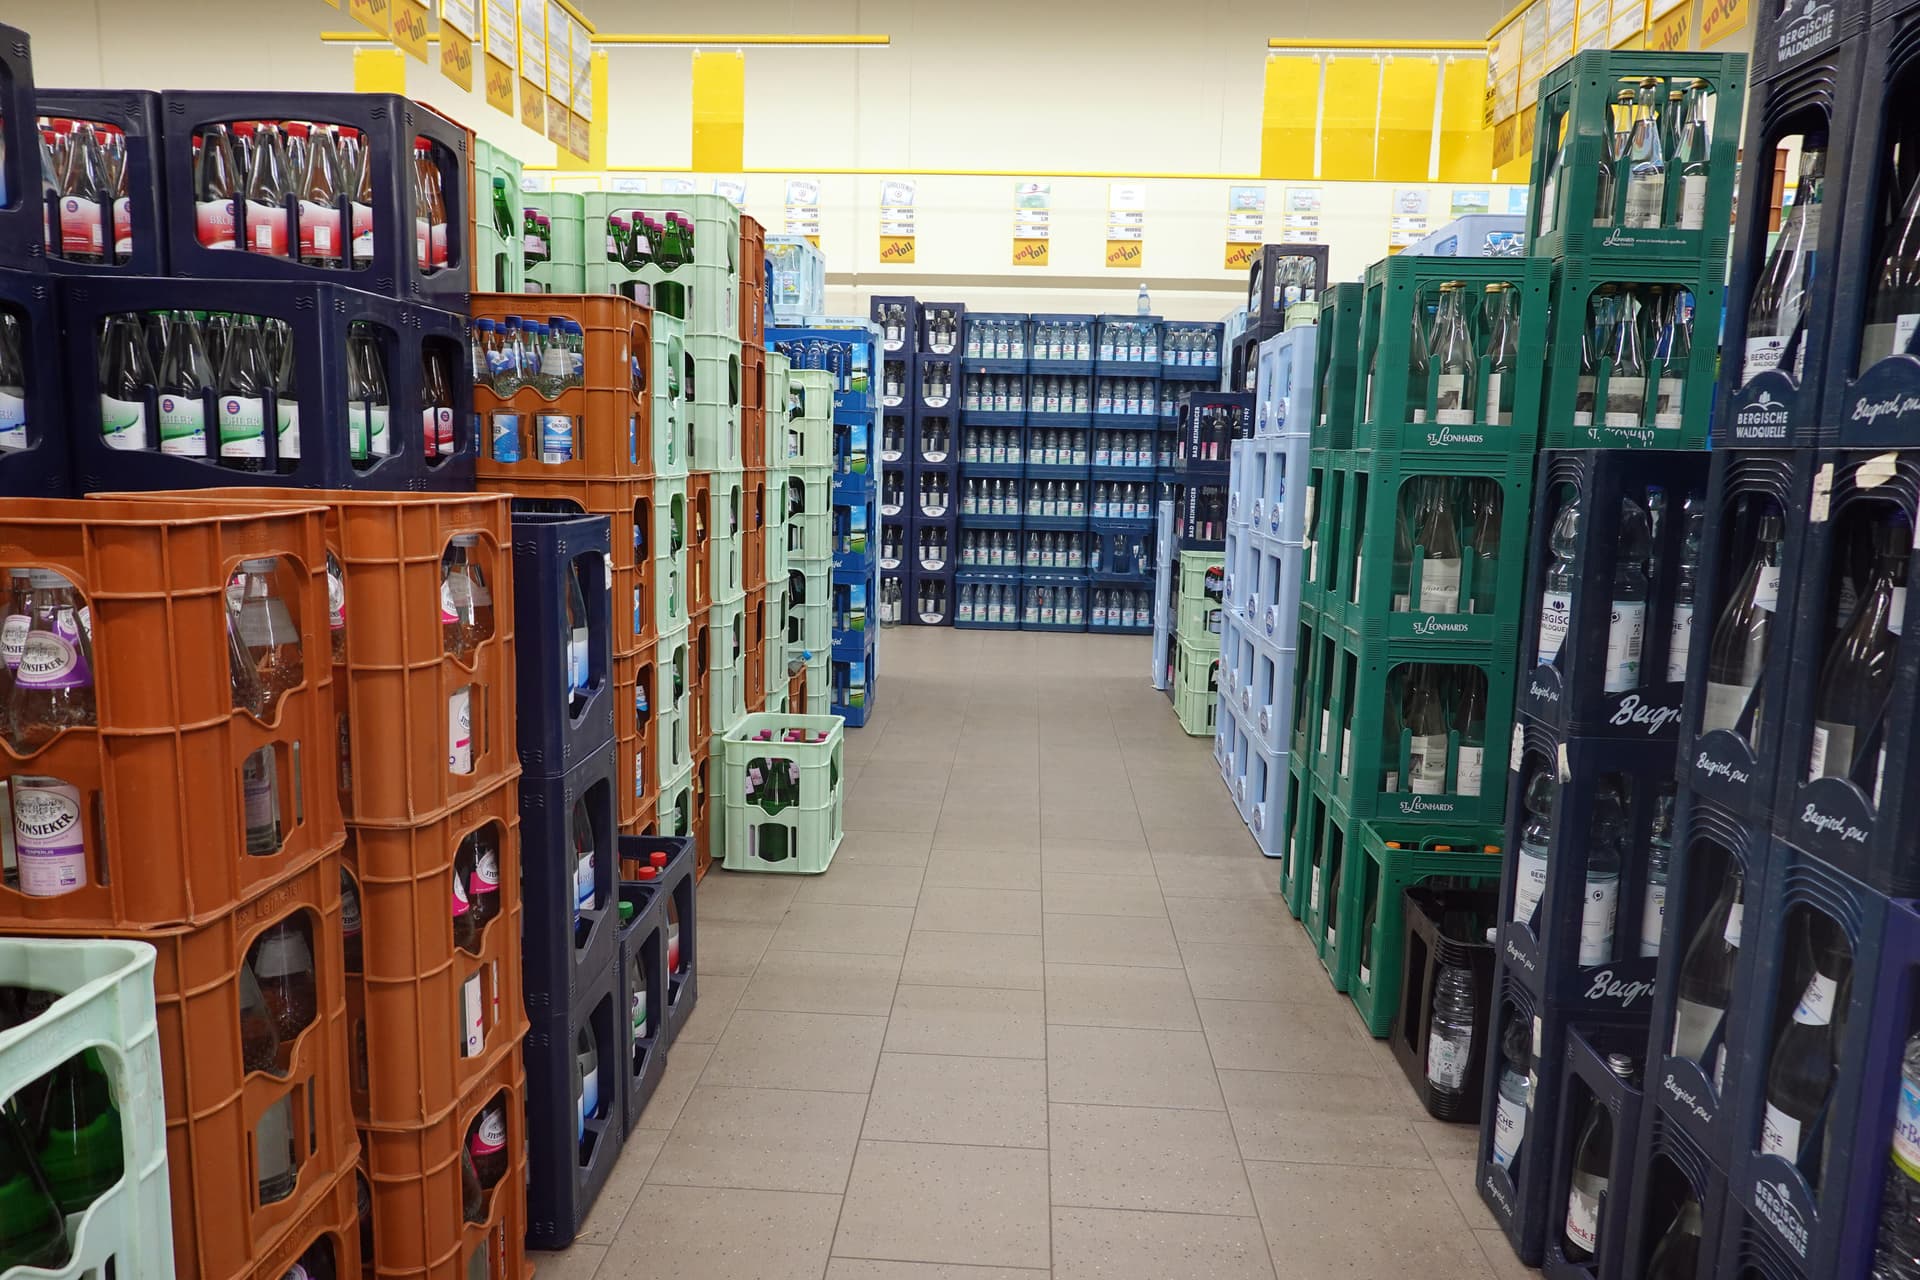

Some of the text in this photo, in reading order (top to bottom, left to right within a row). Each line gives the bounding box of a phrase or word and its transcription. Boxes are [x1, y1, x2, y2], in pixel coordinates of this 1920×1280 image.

[1779, 9, 1835, 48] BERGISCHE
[1777, 25, 1833, 63] WALDQUELLE
[881, 241, 913, 259] voll toll
[1015, 244, 1047, 260] voll toll
[1108, 246, 1140, 262] voll toll
[1227, 249, 1247, 265] voll
[1737, 411, 1789, 425] BERGISCHE
[1429, 426, 1483, 446] LEONHARDS
[1736, 426, 1787, 438] WALDQUELLE
[1415, 616, 1468, 634] LEONHARDS
[1696, 751, 1732, 777] Bergisch
[1402, 795, 1454, 813] LEONHARDS
[1801, 803, 1847, 833] Bergisch
[1756, 1181, 1809, 1244] BERGISCHE
[1755, 1194, 1807, 1259] WALDQUELLE
